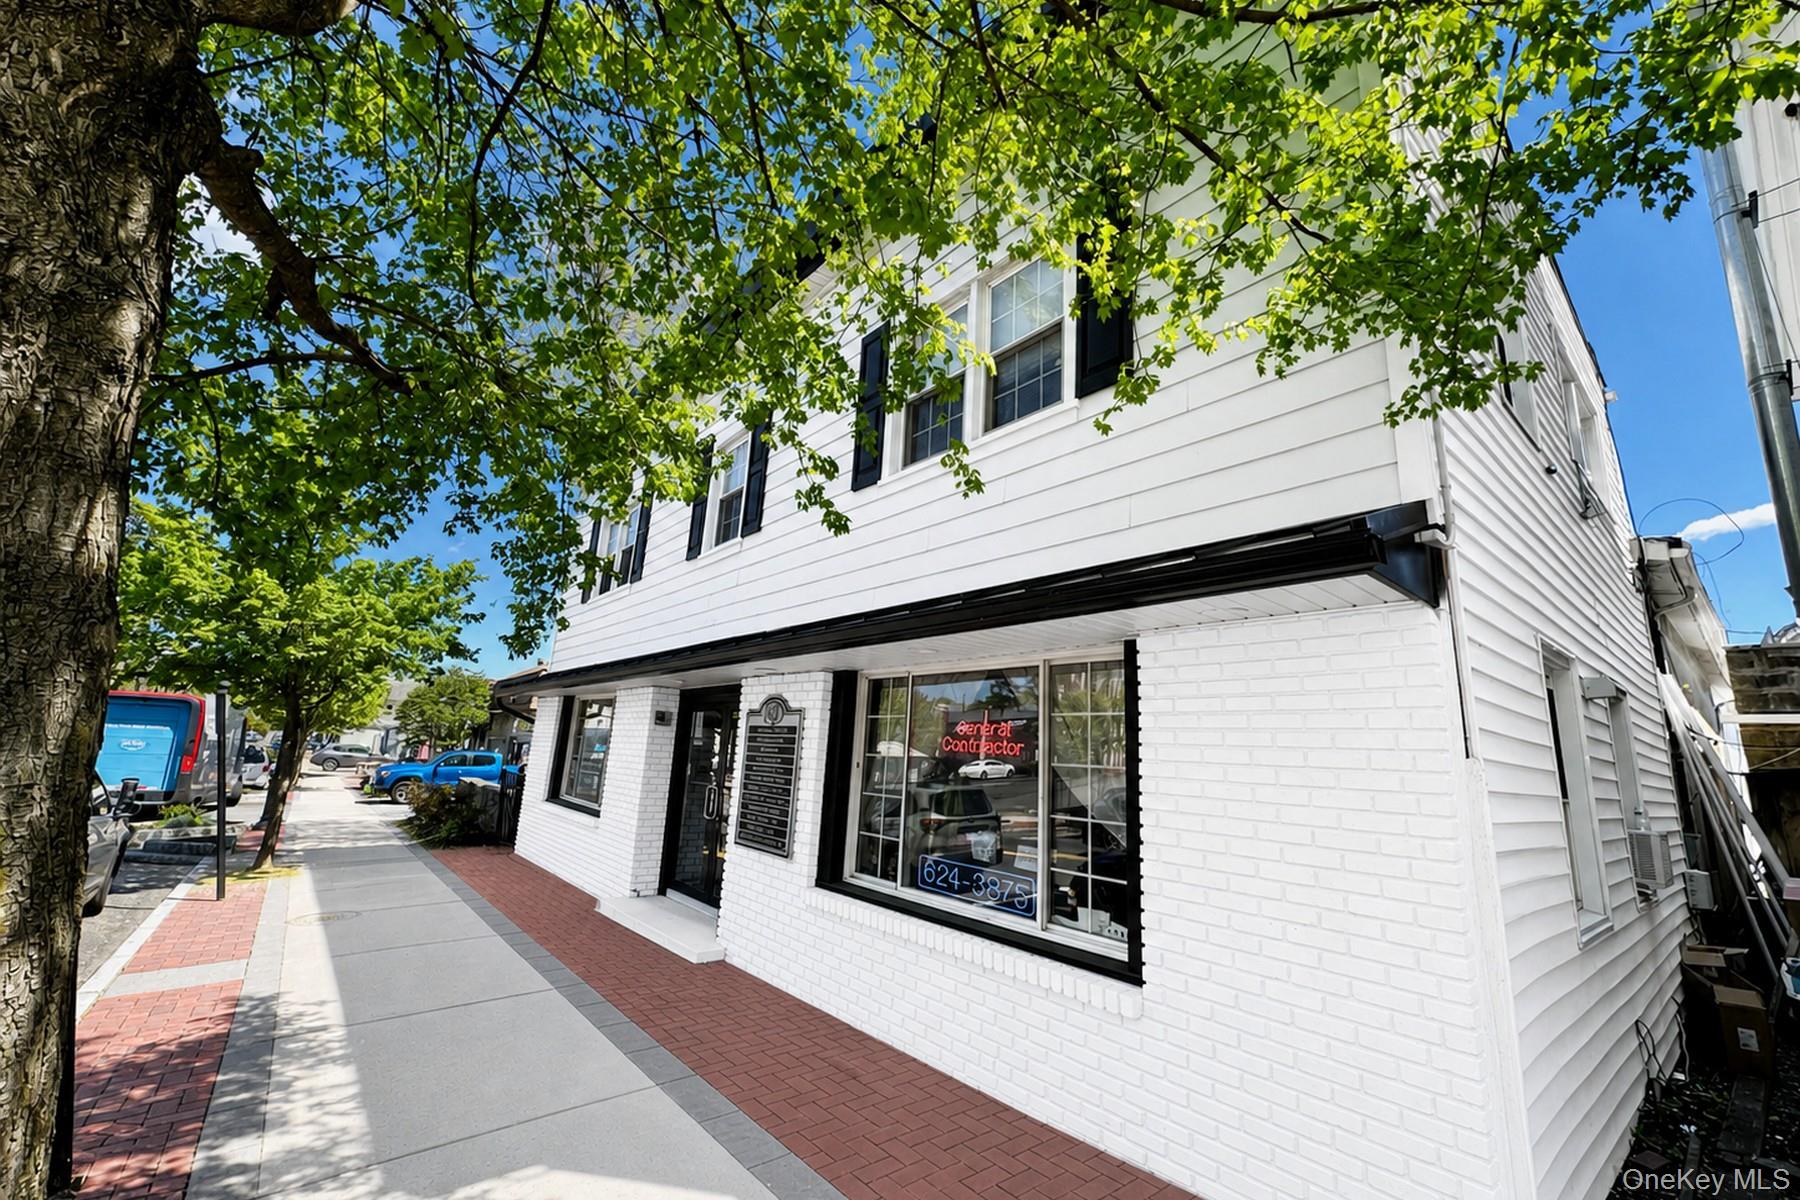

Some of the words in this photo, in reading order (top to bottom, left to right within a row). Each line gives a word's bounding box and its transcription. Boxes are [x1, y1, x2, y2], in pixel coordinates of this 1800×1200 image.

[956, 720, 1013, 737] General
[942, 735, 1024, 756] Contractor
[923, 859, 1031, 910] 624-3875
